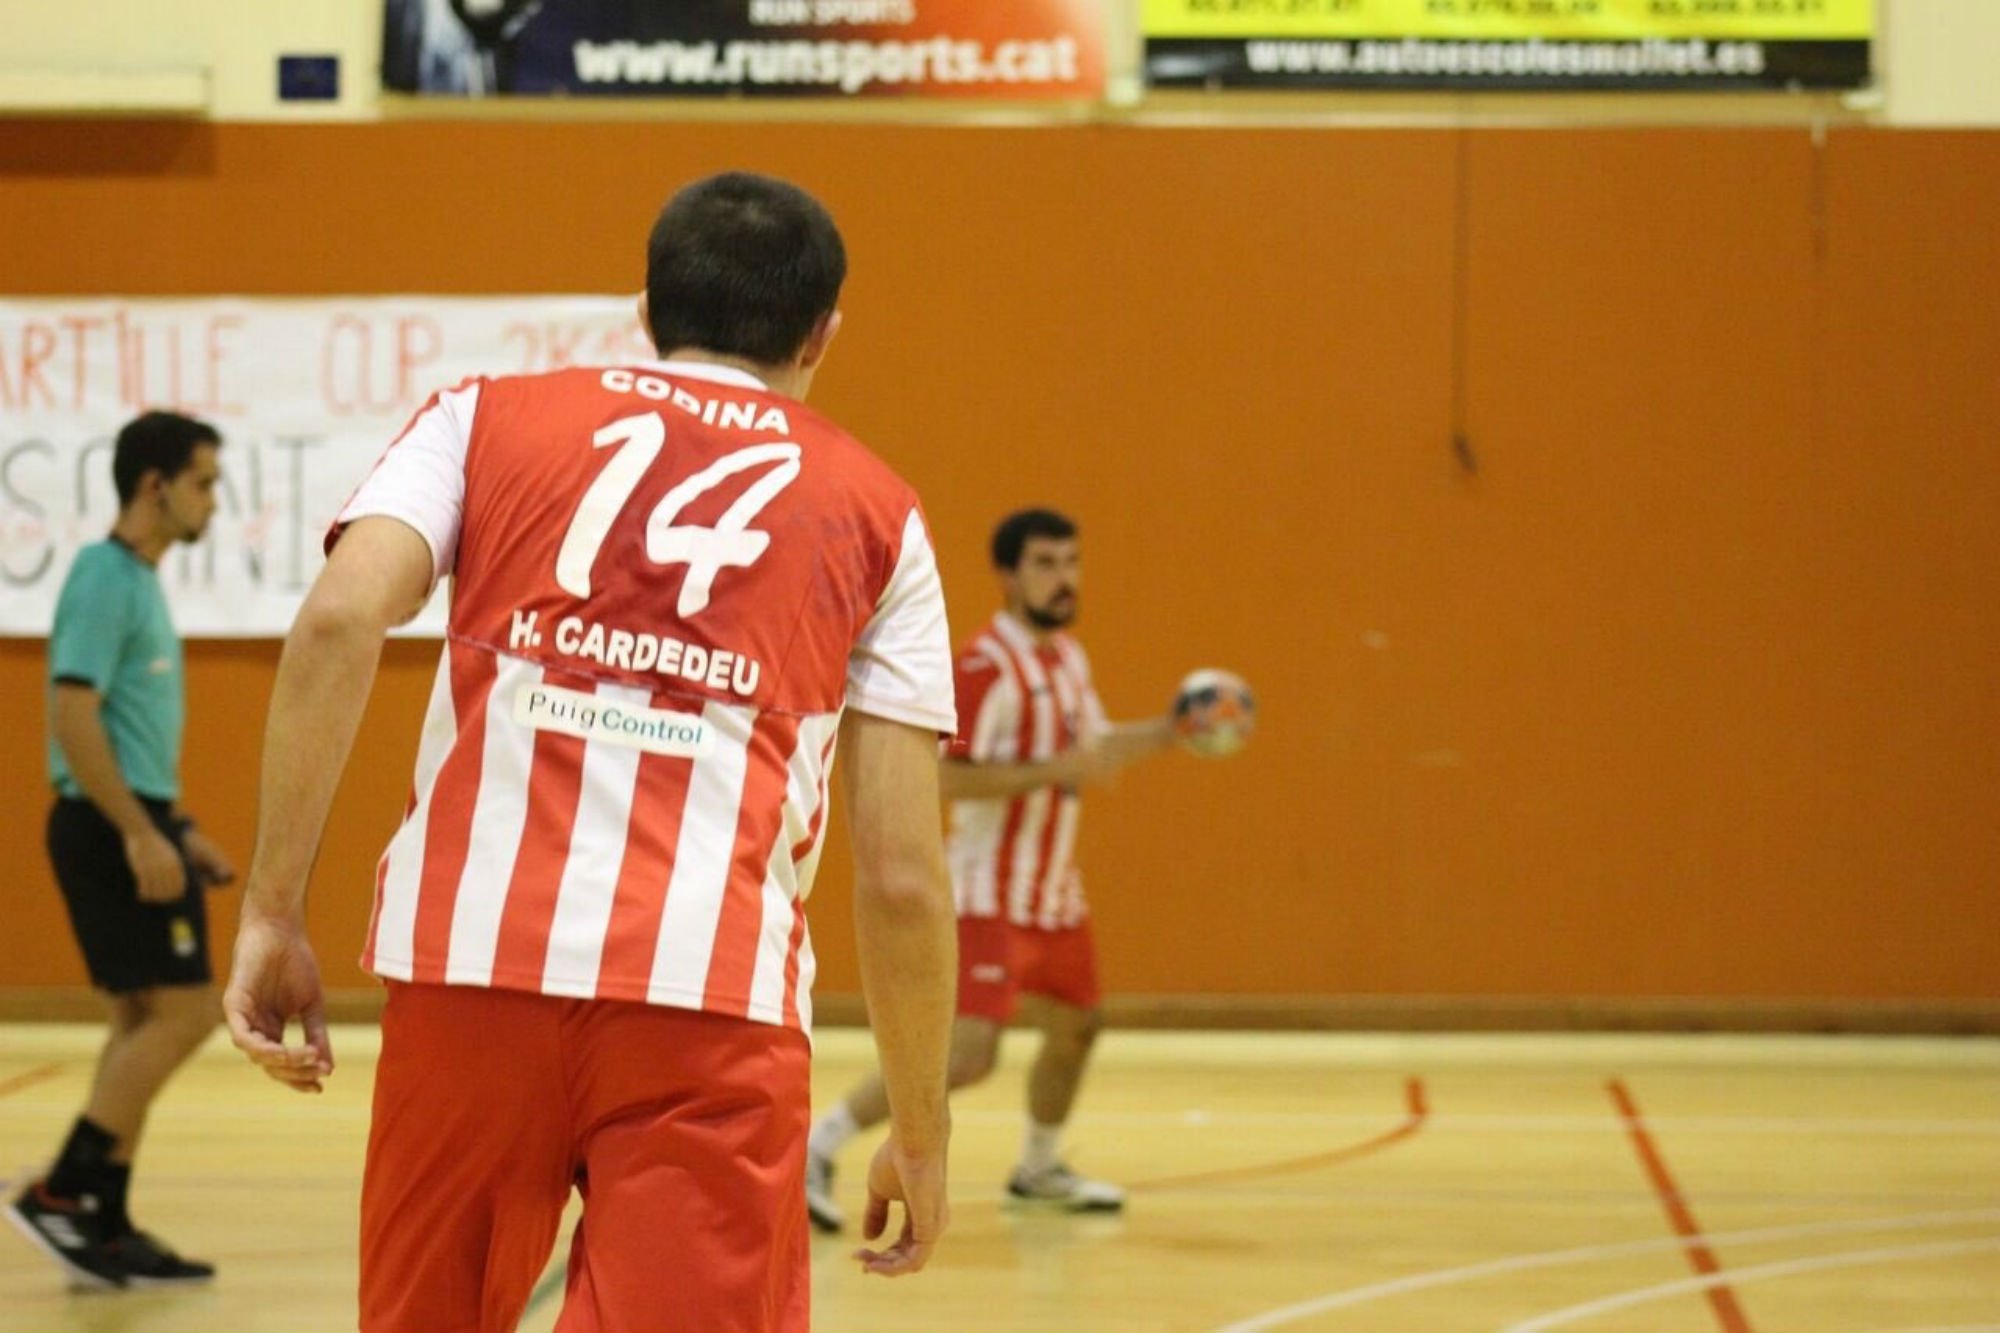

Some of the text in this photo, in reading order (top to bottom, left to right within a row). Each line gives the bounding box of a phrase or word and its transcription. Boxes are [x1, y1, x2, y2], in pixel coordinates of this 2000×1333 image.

[573, 34, 1079, 93] www.runsports.cat
[600, 368, 791, 436] CODINA
[554, 410, 802, 619] 14
[509, 609, 761, 697] H. CARDEDEU
